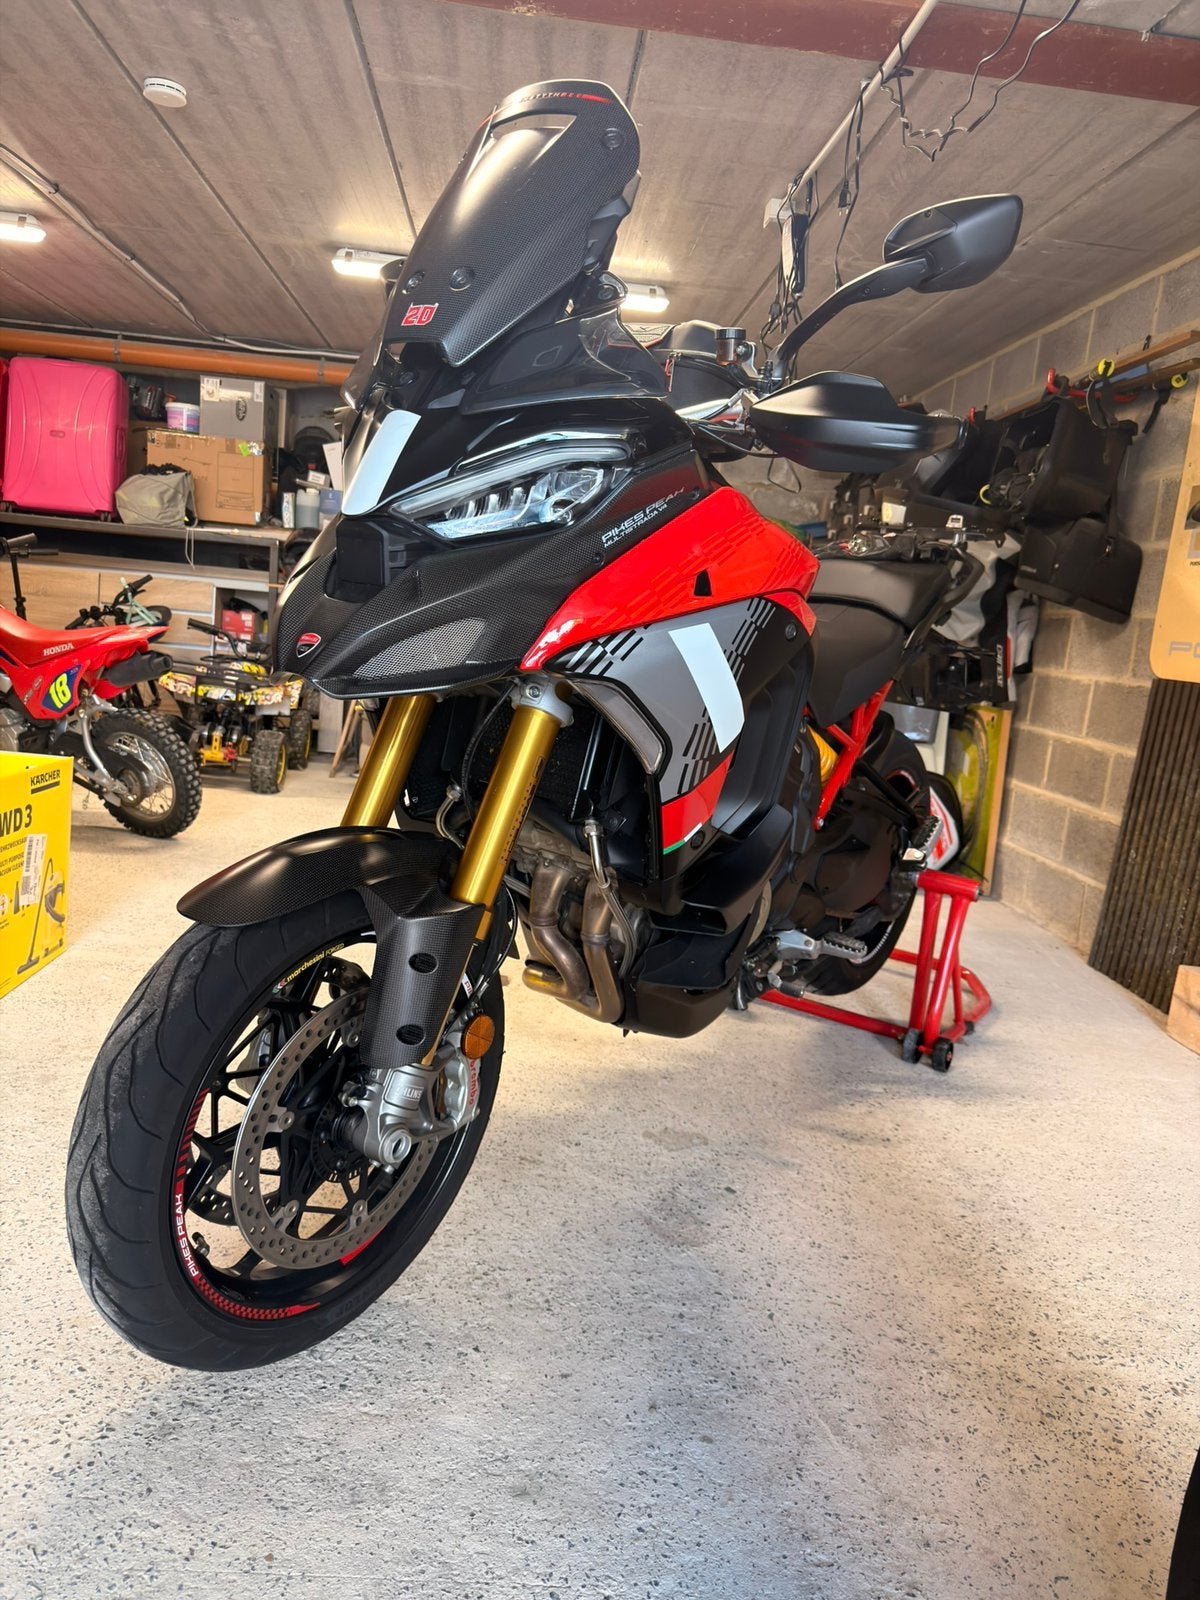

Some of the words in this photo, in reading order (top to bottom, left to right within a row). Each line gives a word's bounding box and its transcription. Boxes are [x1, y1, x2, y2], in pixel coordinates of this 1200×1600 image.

[401, 302, 439, 326] 20
[602, 510, 644, 543] PIKES
[43, 642, 75, 657] HONDA
[49, 672, 72, 710] 18
[24, 803, 33, 829] 3
[287, 951, 325, 983] marchesini
[175, 1193, 185, 1236] PEAK
[180, 1236, 200, 1277] PIKES
